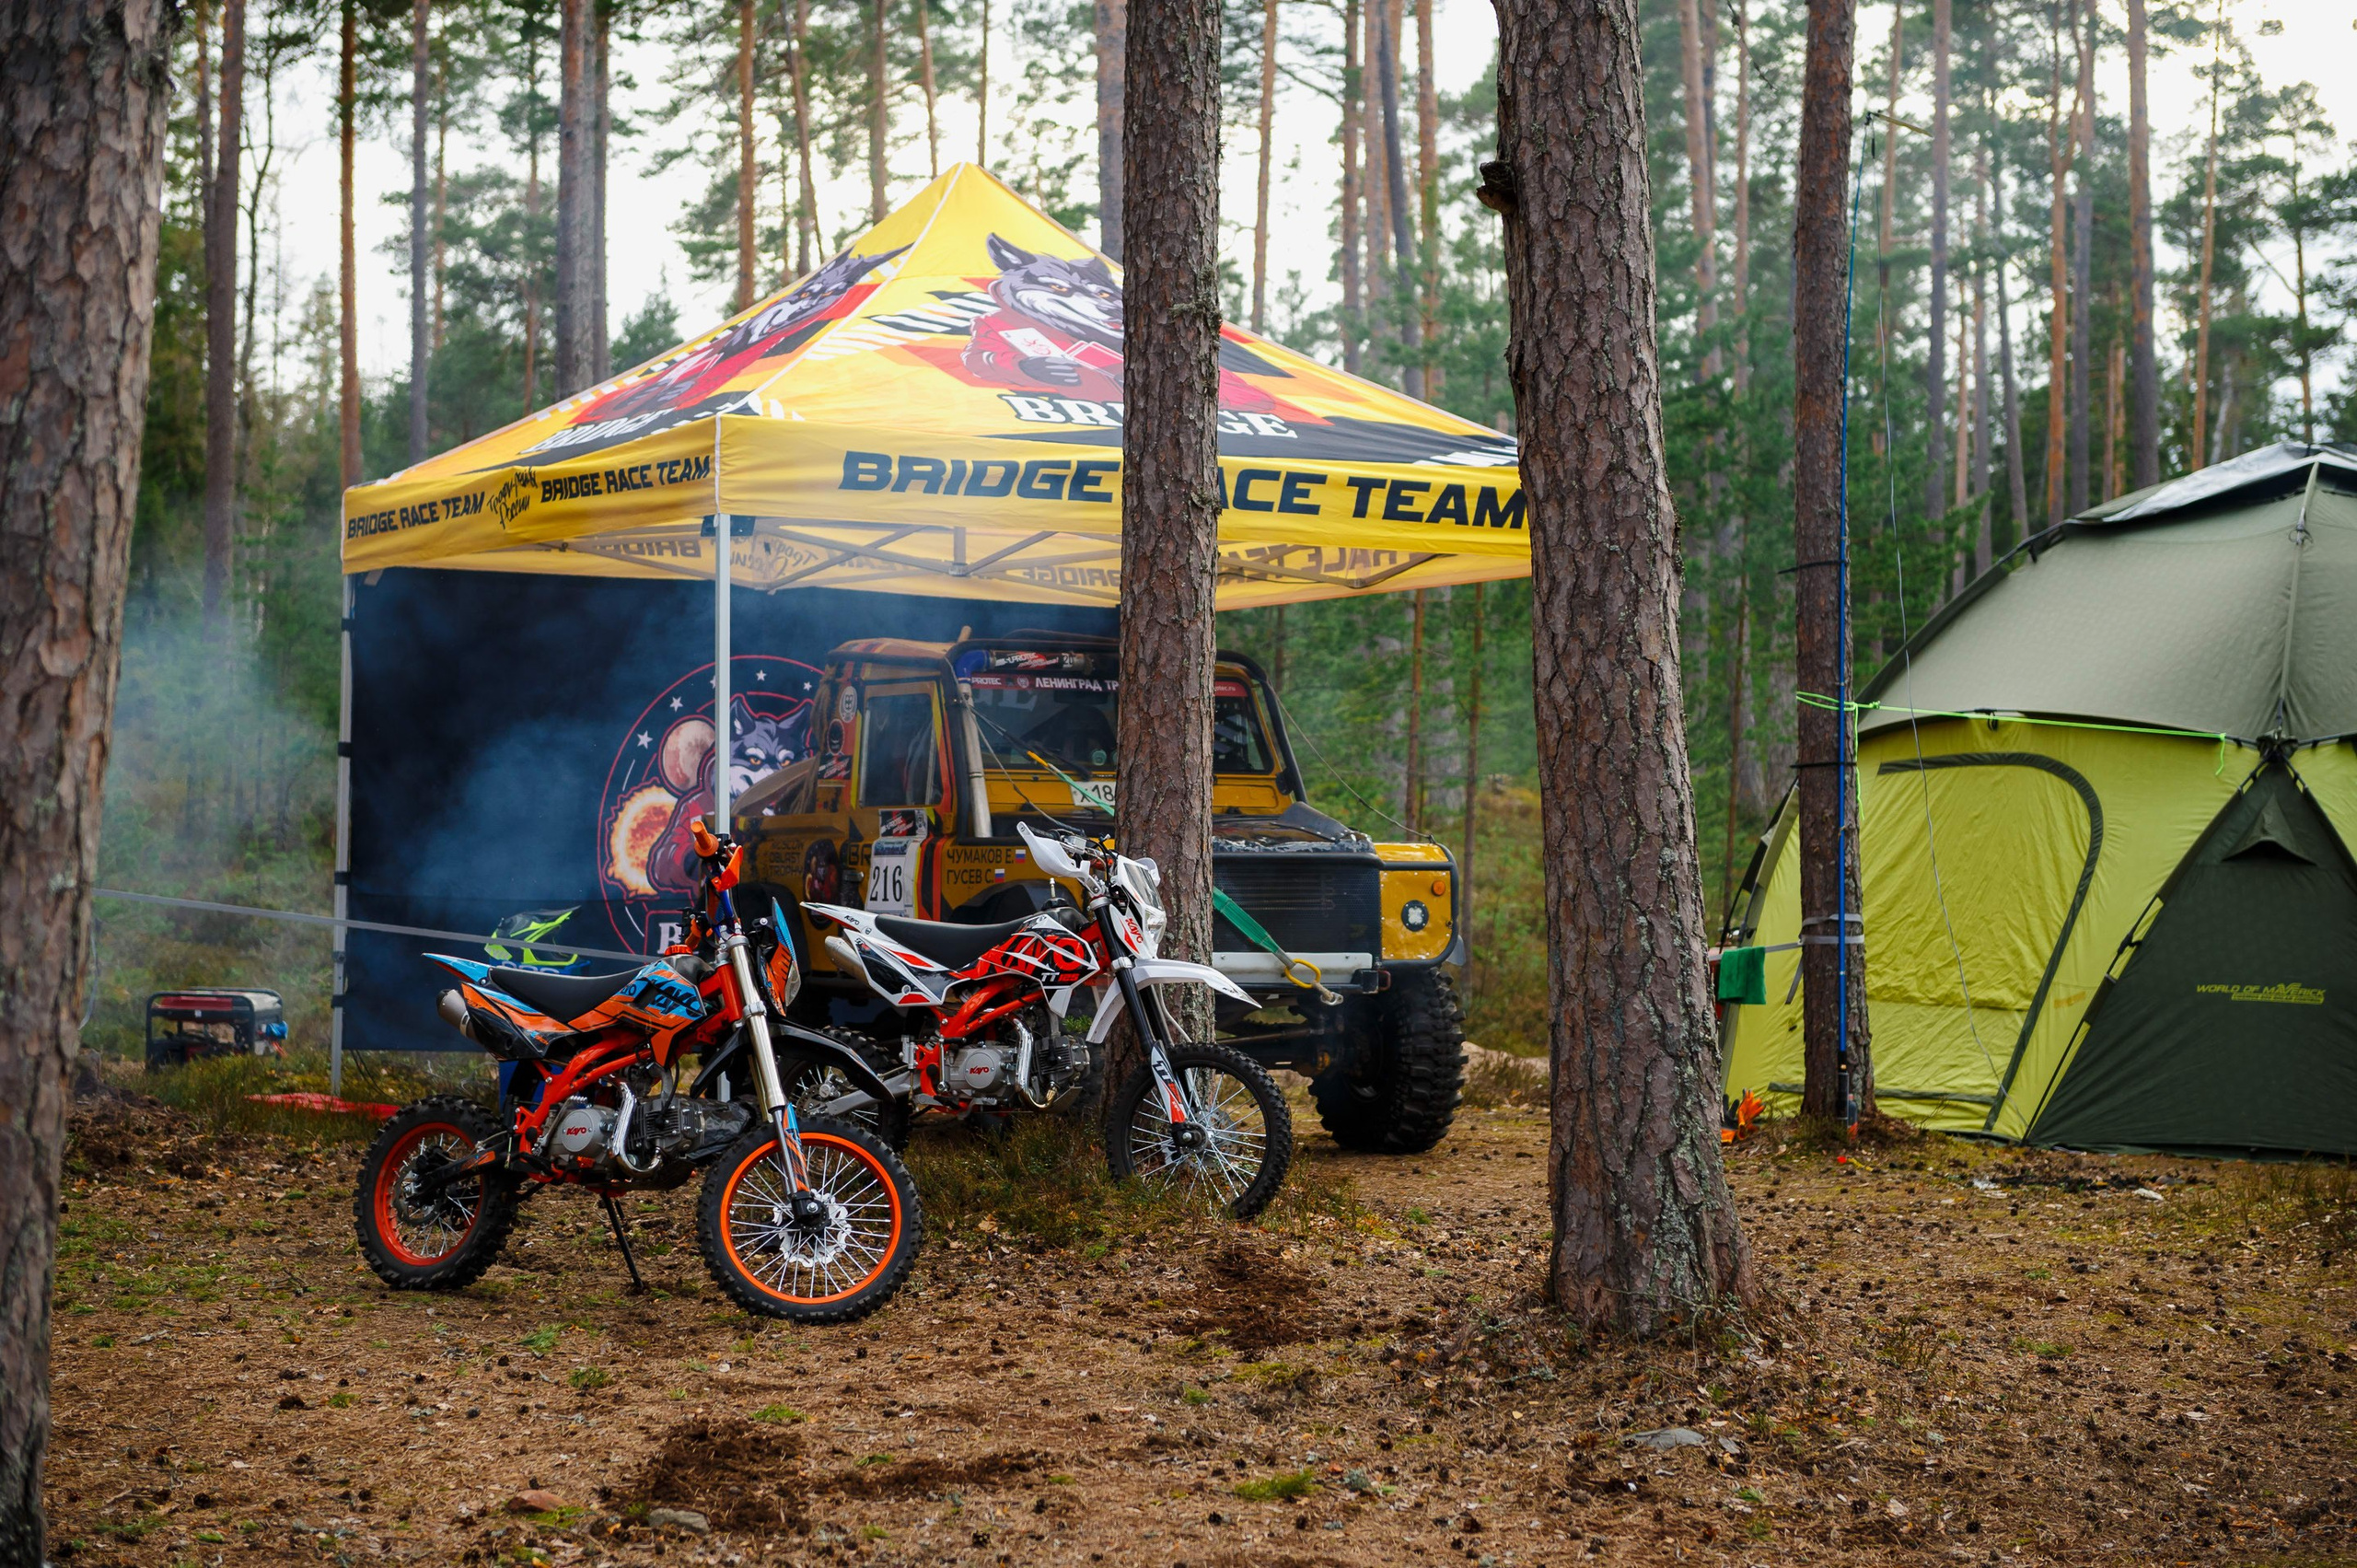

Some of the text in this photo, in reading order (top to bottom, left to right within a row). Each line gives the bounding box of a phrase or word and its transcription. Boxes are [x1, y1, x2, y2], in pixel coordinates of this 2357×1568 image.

[1002, 395, 1298, 439] BRGE
[540, 455, 710, 503] BRIDGE RACE TEAM
[838, 450, 1528, 529] BRIDGE CE TEAM
[347, 491, 485, 539] BRIDGE RACE TEAM
[1035, 677, 1103, 691] ЛЕНИНГРАД
[946, 848, 1003, 864] ЧУМАКОВ
[869, 865, 902, 901] 216
[946, 869, 982, 884] ГУСЕВ
[1124, 917, 1144, 944] KAYO
[2196, 982, 2327, 997] WORLD OF MAVERICK
[970, 1065, 990, 1074] KAYO
[566, 1126, 586, 1136] KAYO
